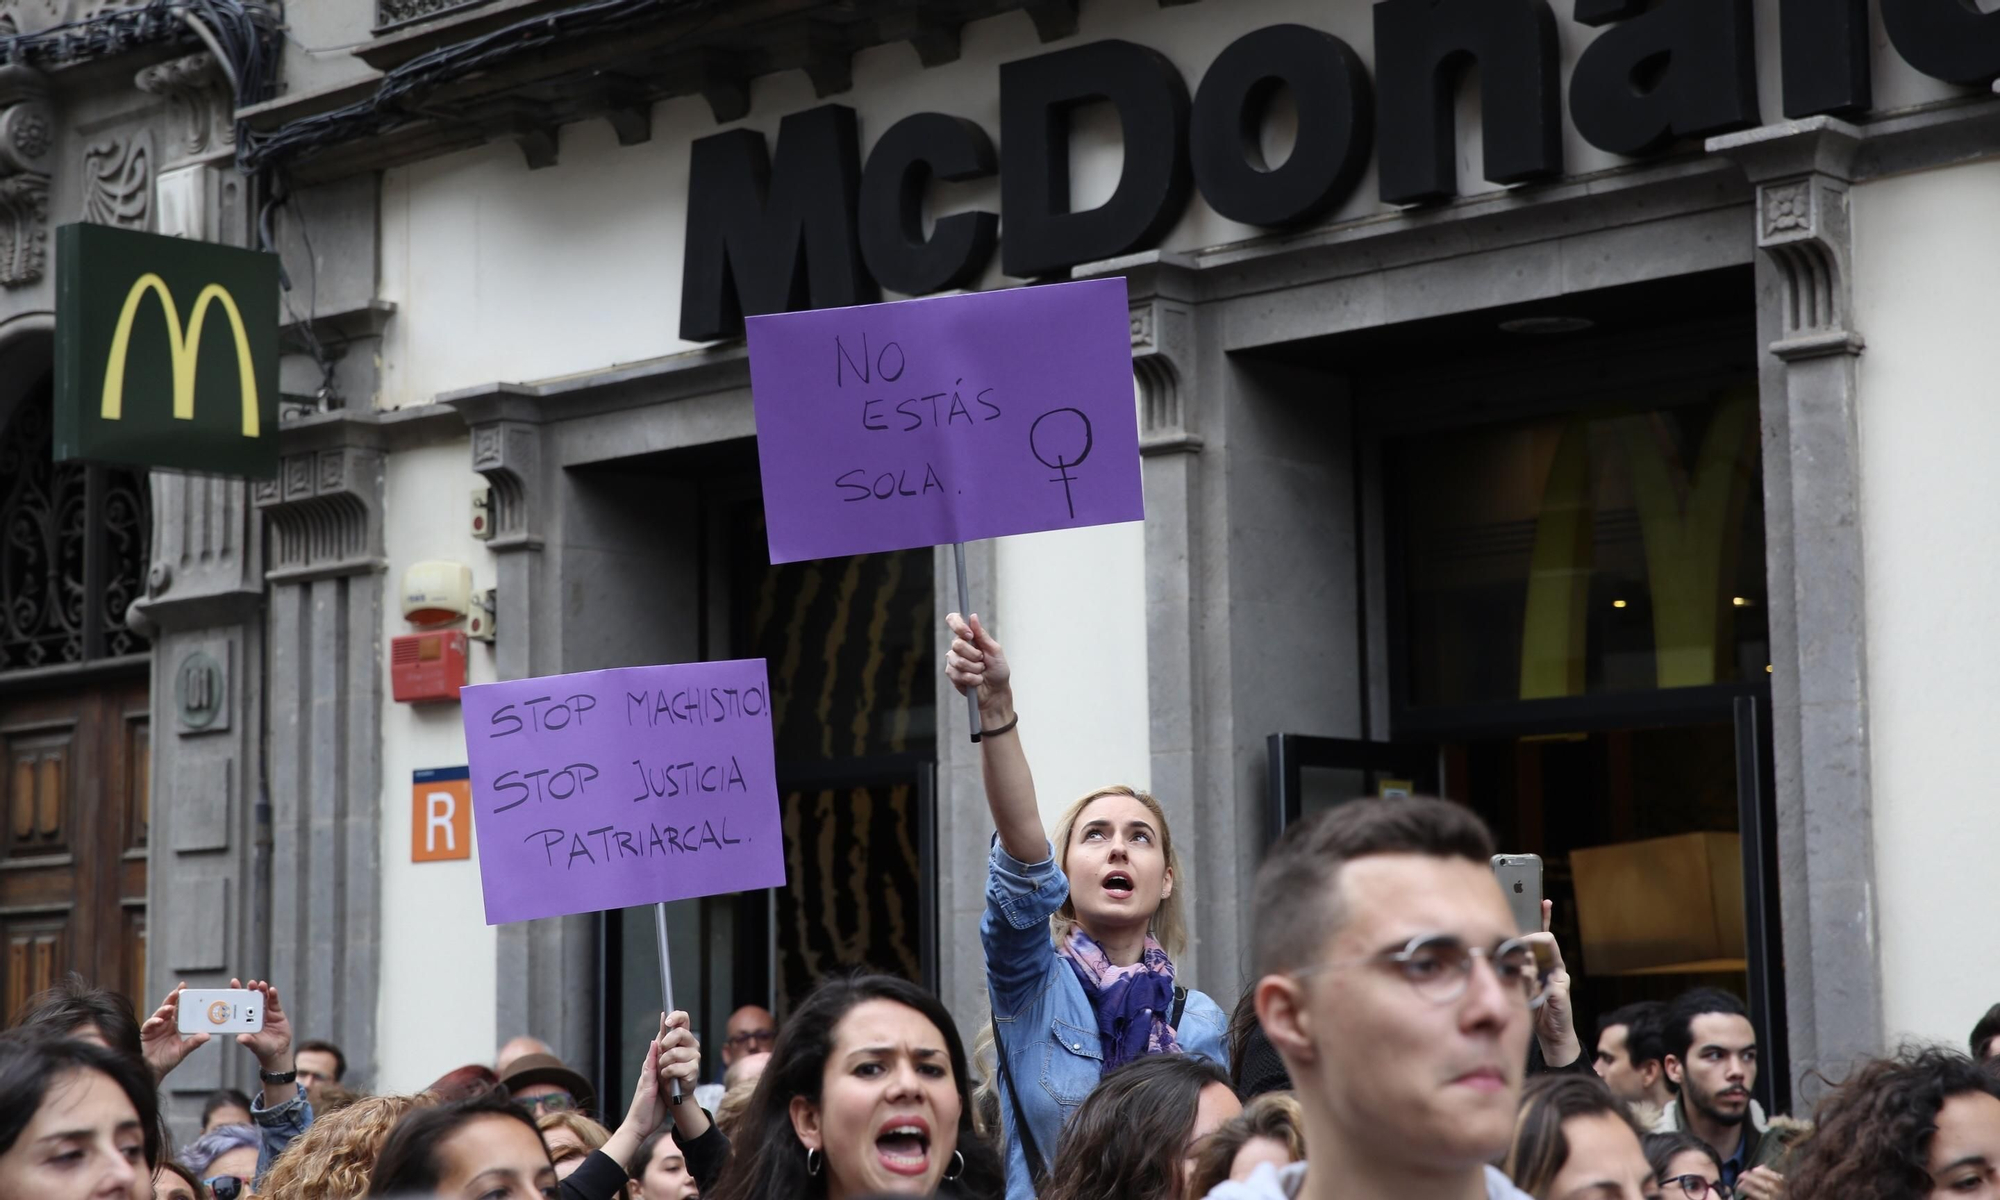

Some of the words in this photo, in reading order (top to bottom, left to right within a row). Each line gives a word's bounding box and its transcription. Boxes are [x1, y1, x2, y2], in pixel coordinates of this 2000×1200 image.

[835, 332, 905, 388] NO
[862, 377, 1001, 432] ESTÁS
[835, 462, 963, 502] SOLA.
[489, 694, 597, 739] STOP
[493, 762, 599, 814] STOP
[632, 755, 747, 802] JUSTICIA
[426, 791, 455, 852] R
[523, 816, 752, 870] PATRIARCAL.
